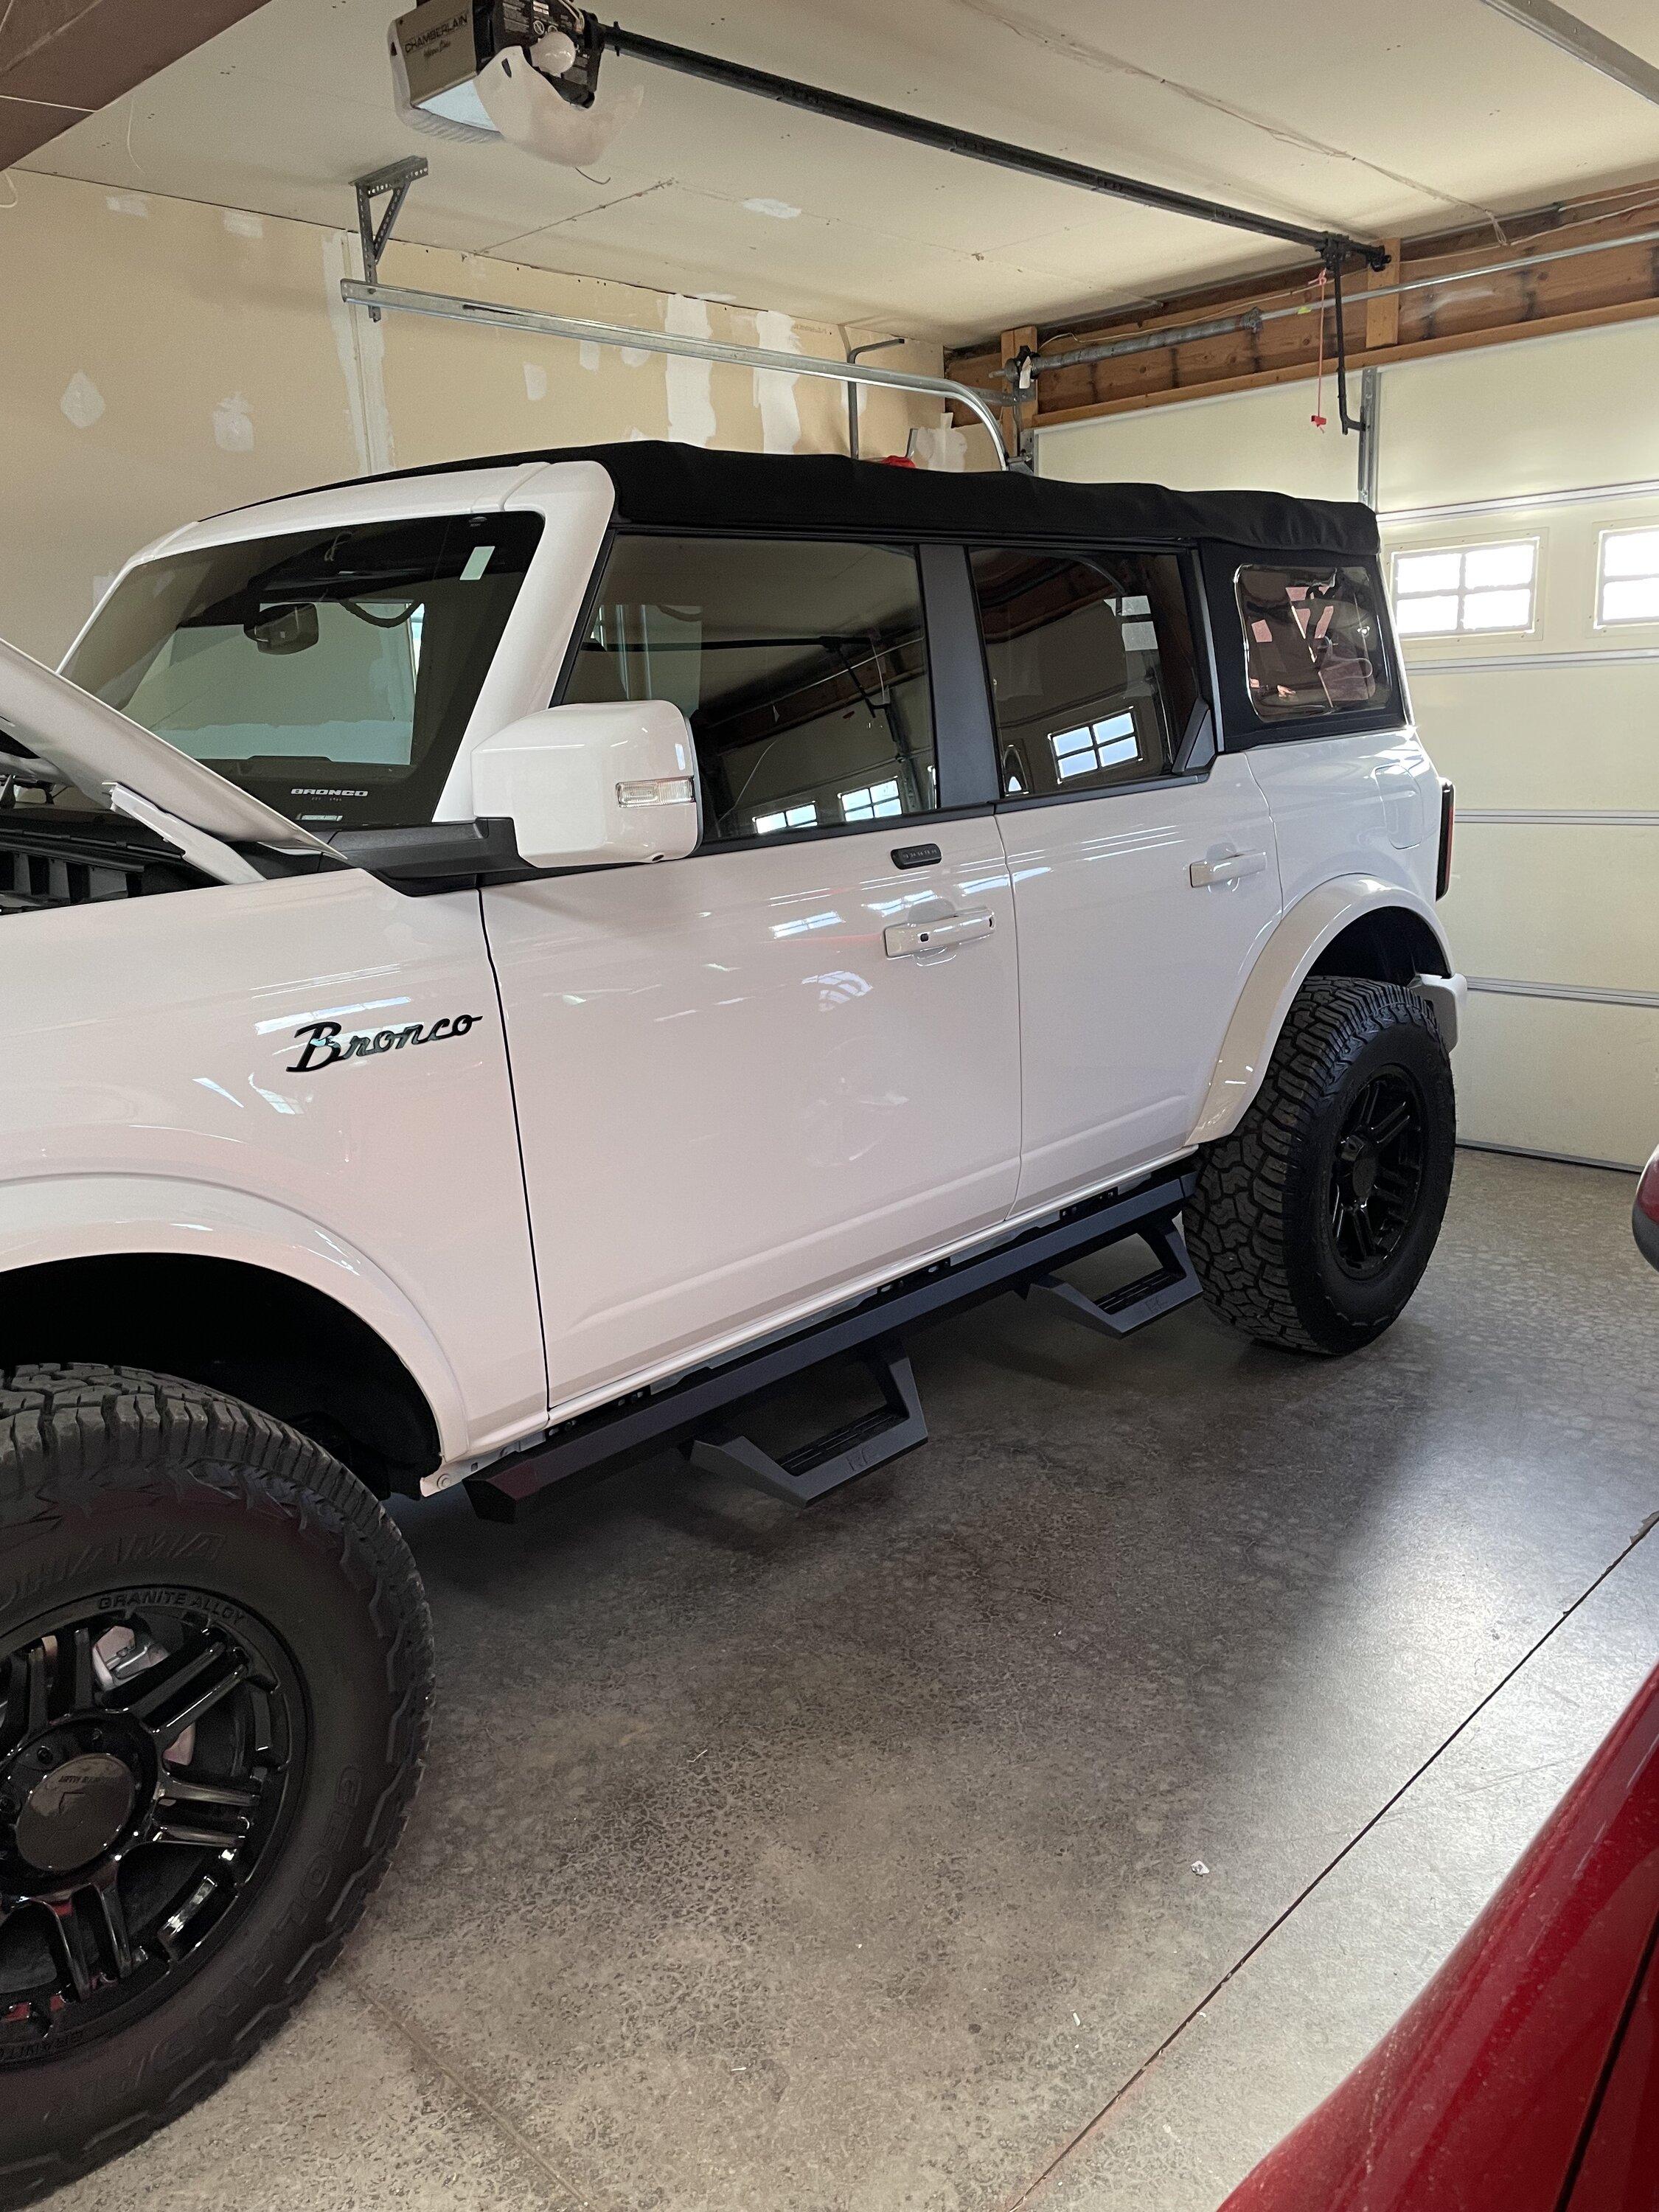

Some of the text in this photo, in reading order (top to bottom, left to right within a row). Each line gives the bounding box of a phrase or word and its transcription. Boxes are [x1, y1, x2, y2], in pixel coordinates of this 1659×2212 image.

[404, 14, 468, 53] CHAMBERLAIN
[291, 788, 369, 797] BRONCO
[286, 1014, 483, 1072] Bronco
[99, 1590, 246, 1624] GRANITE ALLOY
